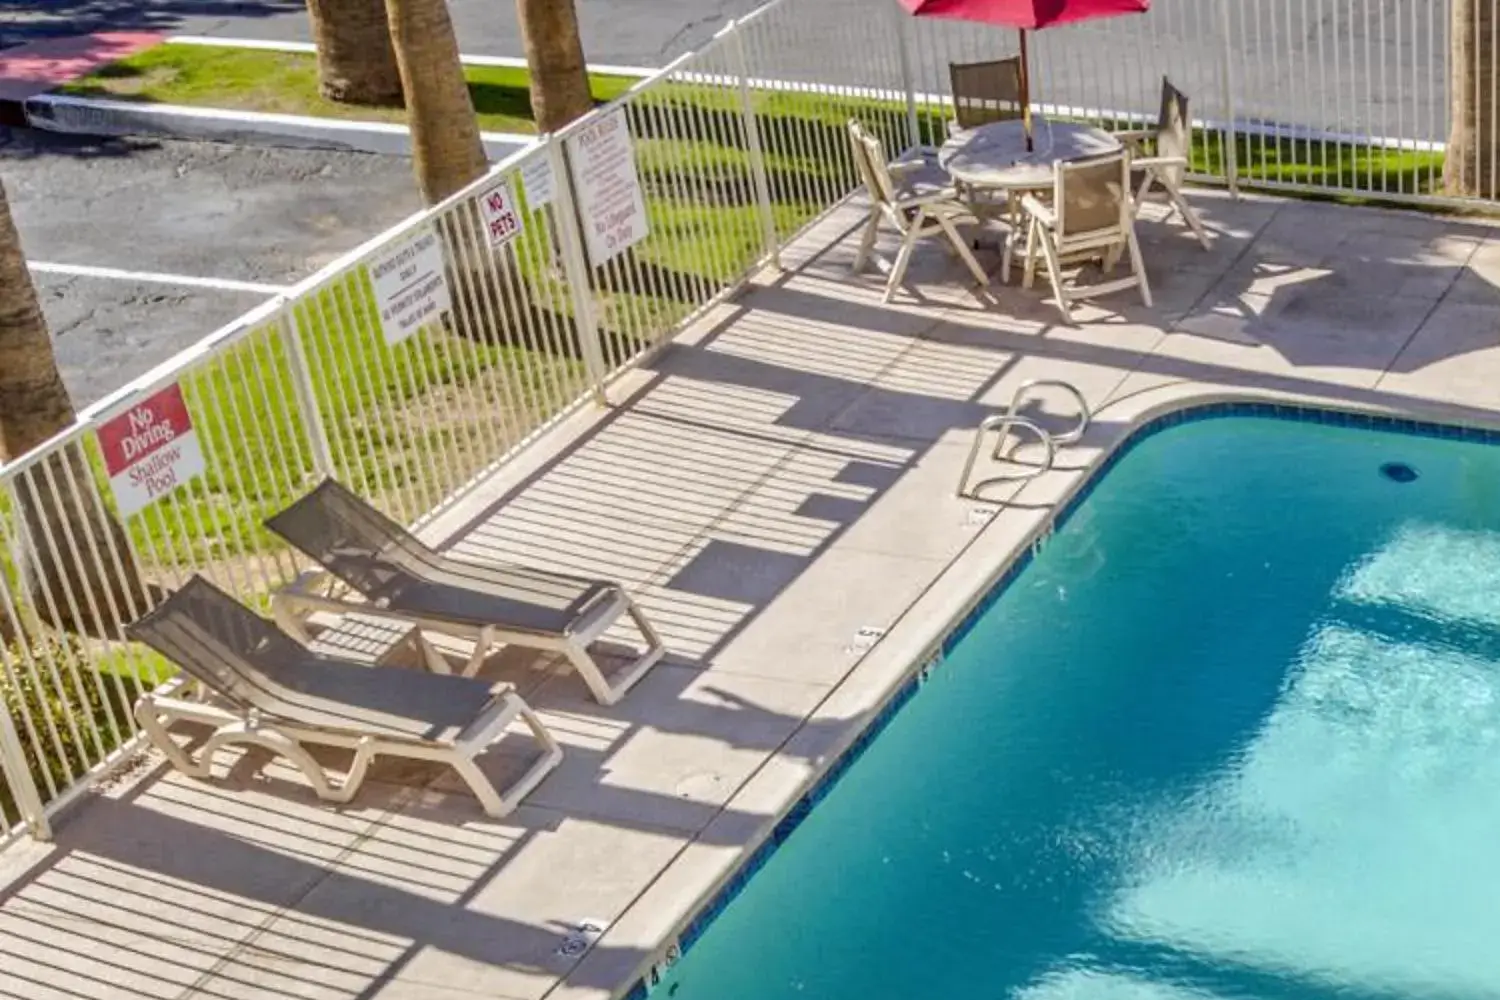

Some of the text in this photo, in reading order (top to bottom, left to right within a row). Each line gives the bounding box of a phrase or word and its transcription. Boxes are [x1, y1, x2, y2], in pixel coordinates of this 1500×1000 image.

[487, 191, 503, 212] NO
[490, 212, 515, 237] PETS
[128, 407, 154, 438] No
[121, 418, 175, 460] Diving
[129, 446, 181, 487] Shallow
[145, 465, 177, 497] Pool
[651, 964, 659, 987] 4
